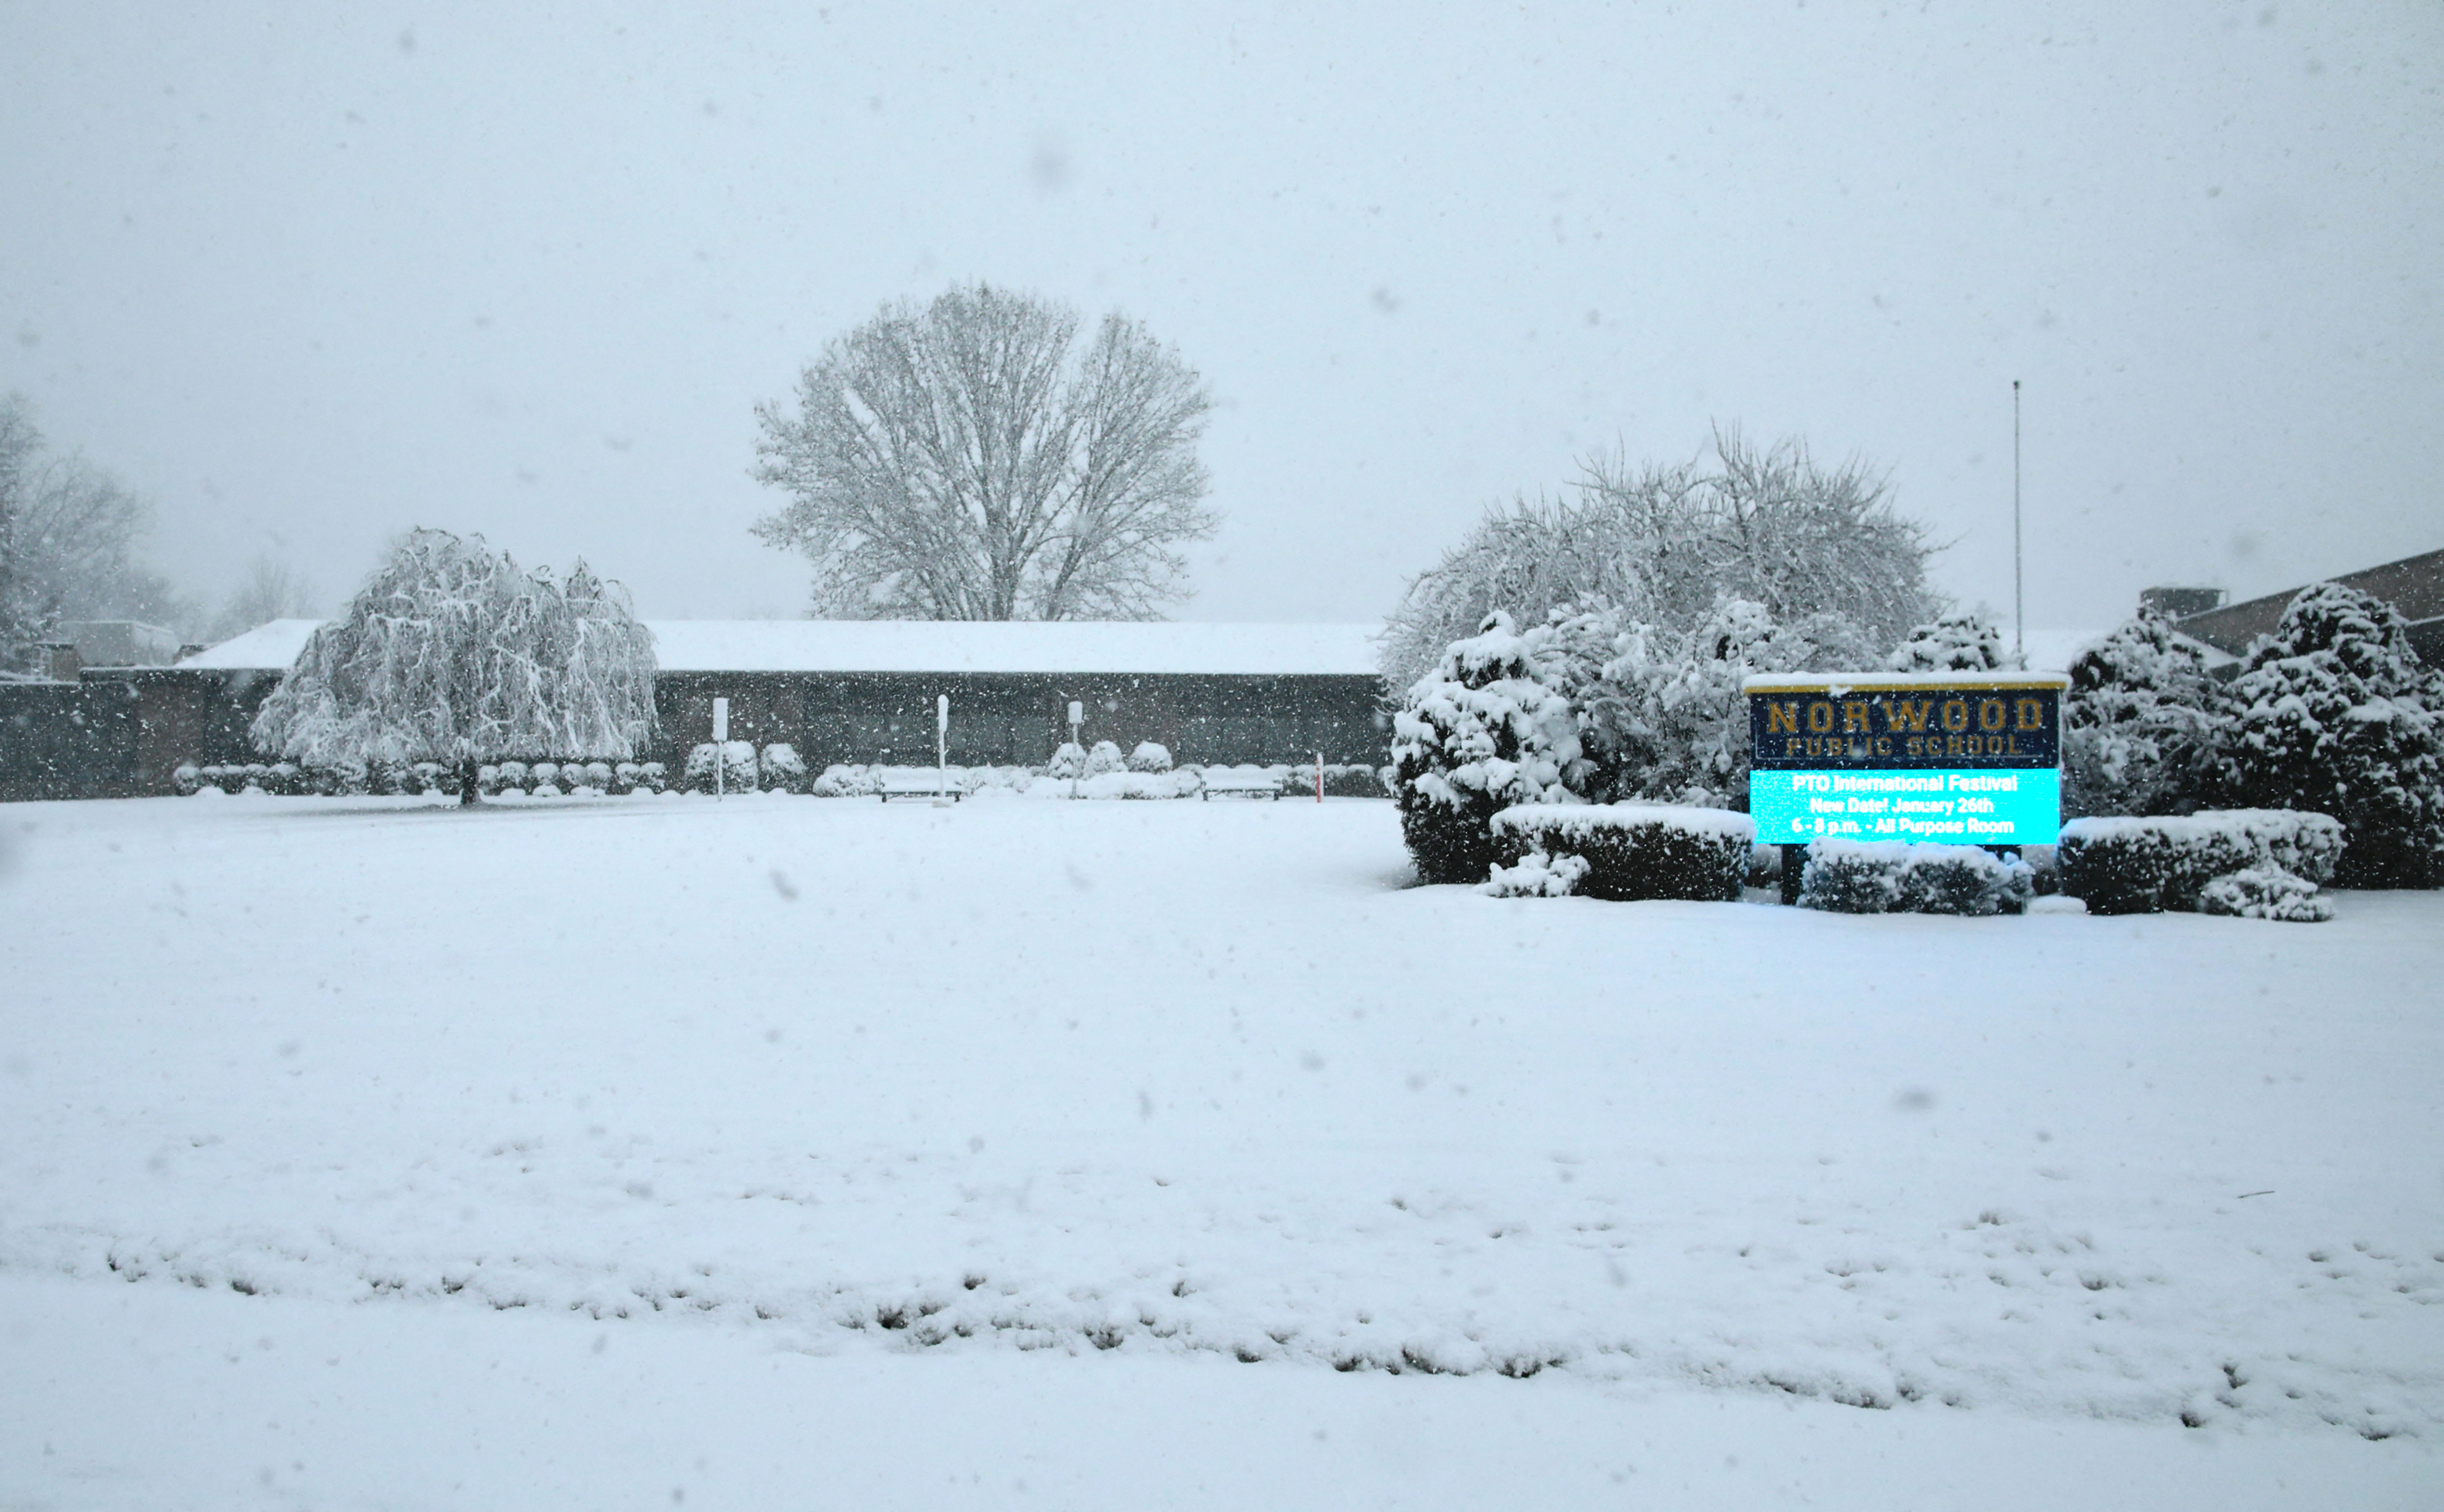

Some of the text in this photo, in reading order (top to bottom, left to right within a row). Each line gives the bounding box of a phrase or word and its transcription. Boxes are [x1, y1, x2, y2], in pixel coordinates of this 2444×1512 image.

[1767, 698, 2042, 733] NORWOOD
[1787, 735, 2022, 756] PUBLIC SCHOOL
[1793, 775, 2017, 791] PTO International Festival
[1811, 797, 1994, 816] New Date! January 26th
[1792, 818, 1802, 833] 6
[1828, 821, 1862, 836] p.m.
[1875, 818, 1896, 833] All
[1899, 818, 1965, 836] Purpose
[1967, 818, 2015, 833] Room
